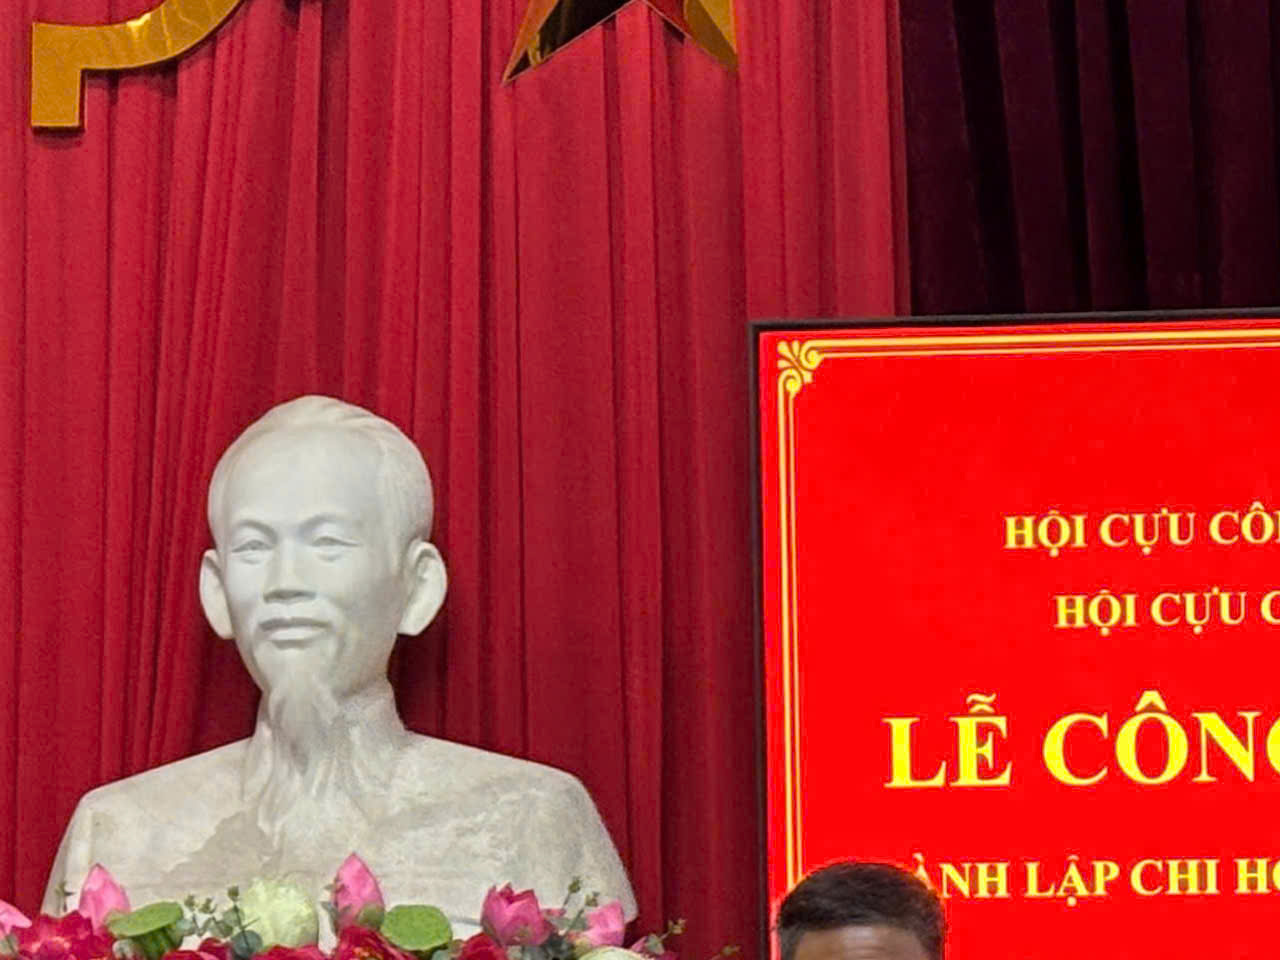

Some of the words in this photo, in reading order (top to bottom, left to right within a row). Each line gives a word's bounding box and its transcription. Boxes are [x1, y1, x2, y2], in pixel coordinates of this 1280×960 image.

[1005, 509, 1086, 557] HỘI
[1099, 506, 1196, 556] CỰU
[1055, 589, 1137, 637] HỘI
[1150, 586, 1247, 634] CỰU
[883, 693, 1013, 789] LỄ
[1024, 853, 1120, 907] LẬP
[1130, 857, 1219, 896] CHI
